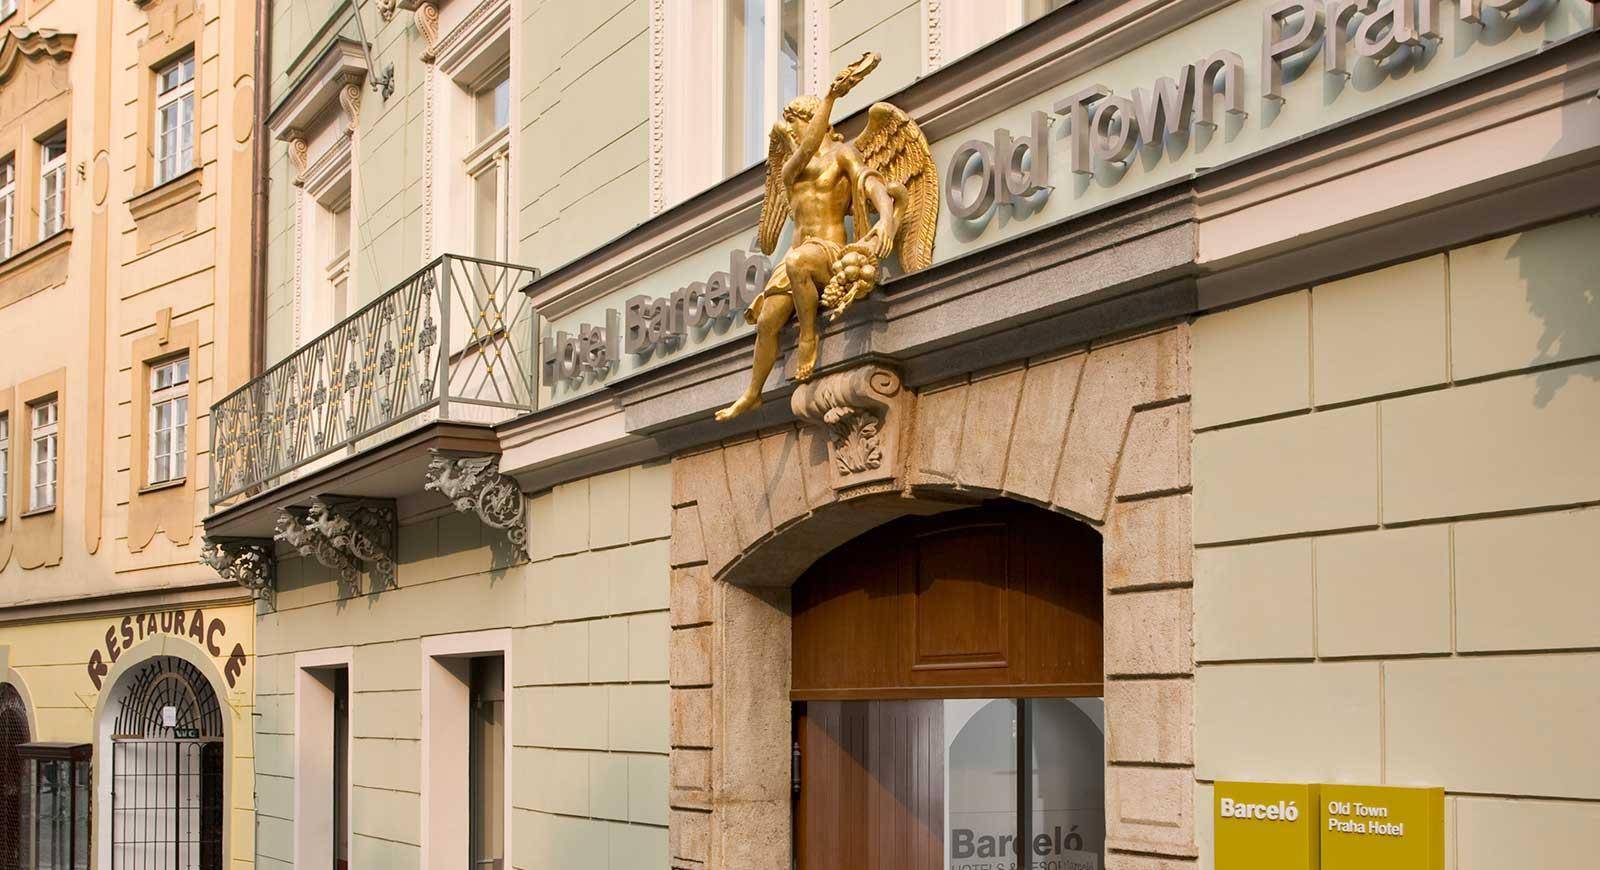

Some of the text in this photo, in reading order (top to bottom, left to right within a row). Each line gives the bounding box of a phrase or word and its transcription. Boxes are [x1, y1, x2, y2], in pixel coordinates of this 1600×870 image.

[543, 308, 621, 386] Hotel
[945, 111, 1049, 220] Old
[1053, 50, 1246, 175] Town
[87, 609, 246, 691] RESTAURACE
[176, 730, 197, 738] WC
[1220, 798, 1299, 821] Barceló
[1328, 801, 1387, 817] Old Town
[1328, 819, 1404, 836] Praha Hotel
[951, 825, 1083, 859] Bareló
